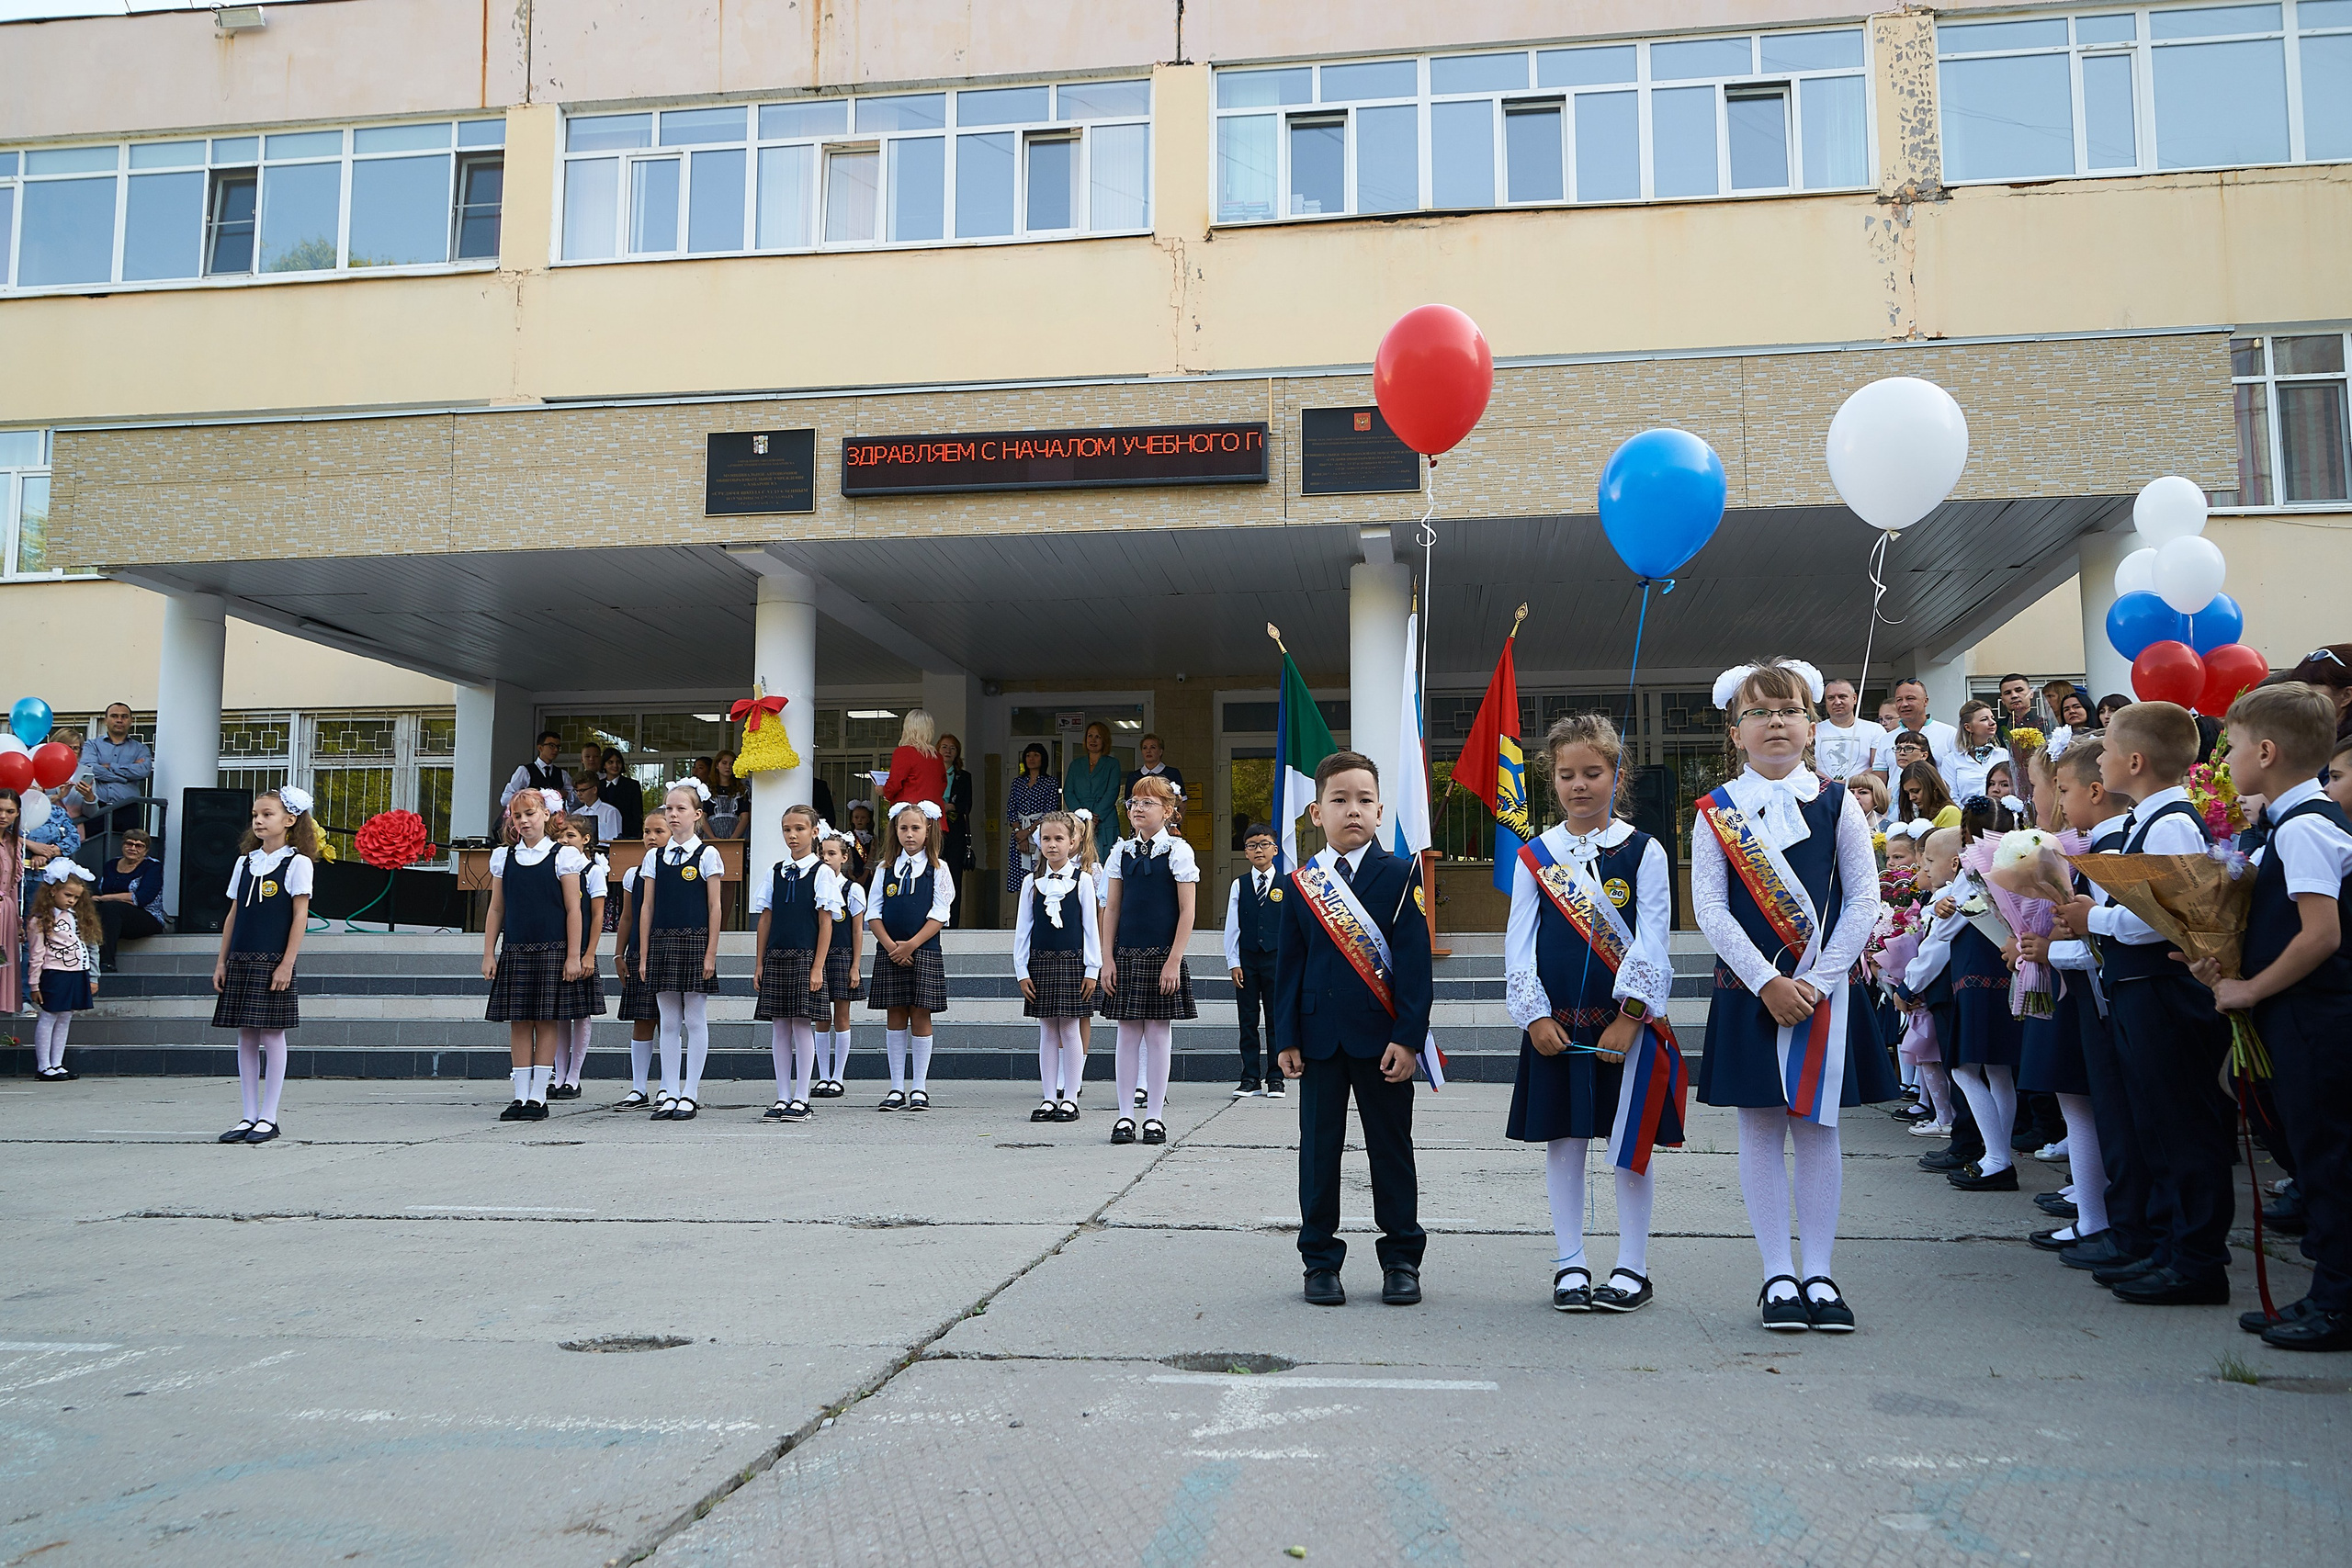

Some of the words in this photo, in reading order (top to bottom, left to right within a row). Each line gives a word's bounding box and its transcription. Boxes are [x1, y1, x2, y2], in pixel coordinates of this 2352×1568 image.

[847, 442, 975, 466] ЗДРАВЛЯЕМ
[981, 441, 996, 460] С
[1002, 437, 1115, 460] НАЧАЛОМ
[1122, 433, 1240, 456] УЧЕБНОГО
